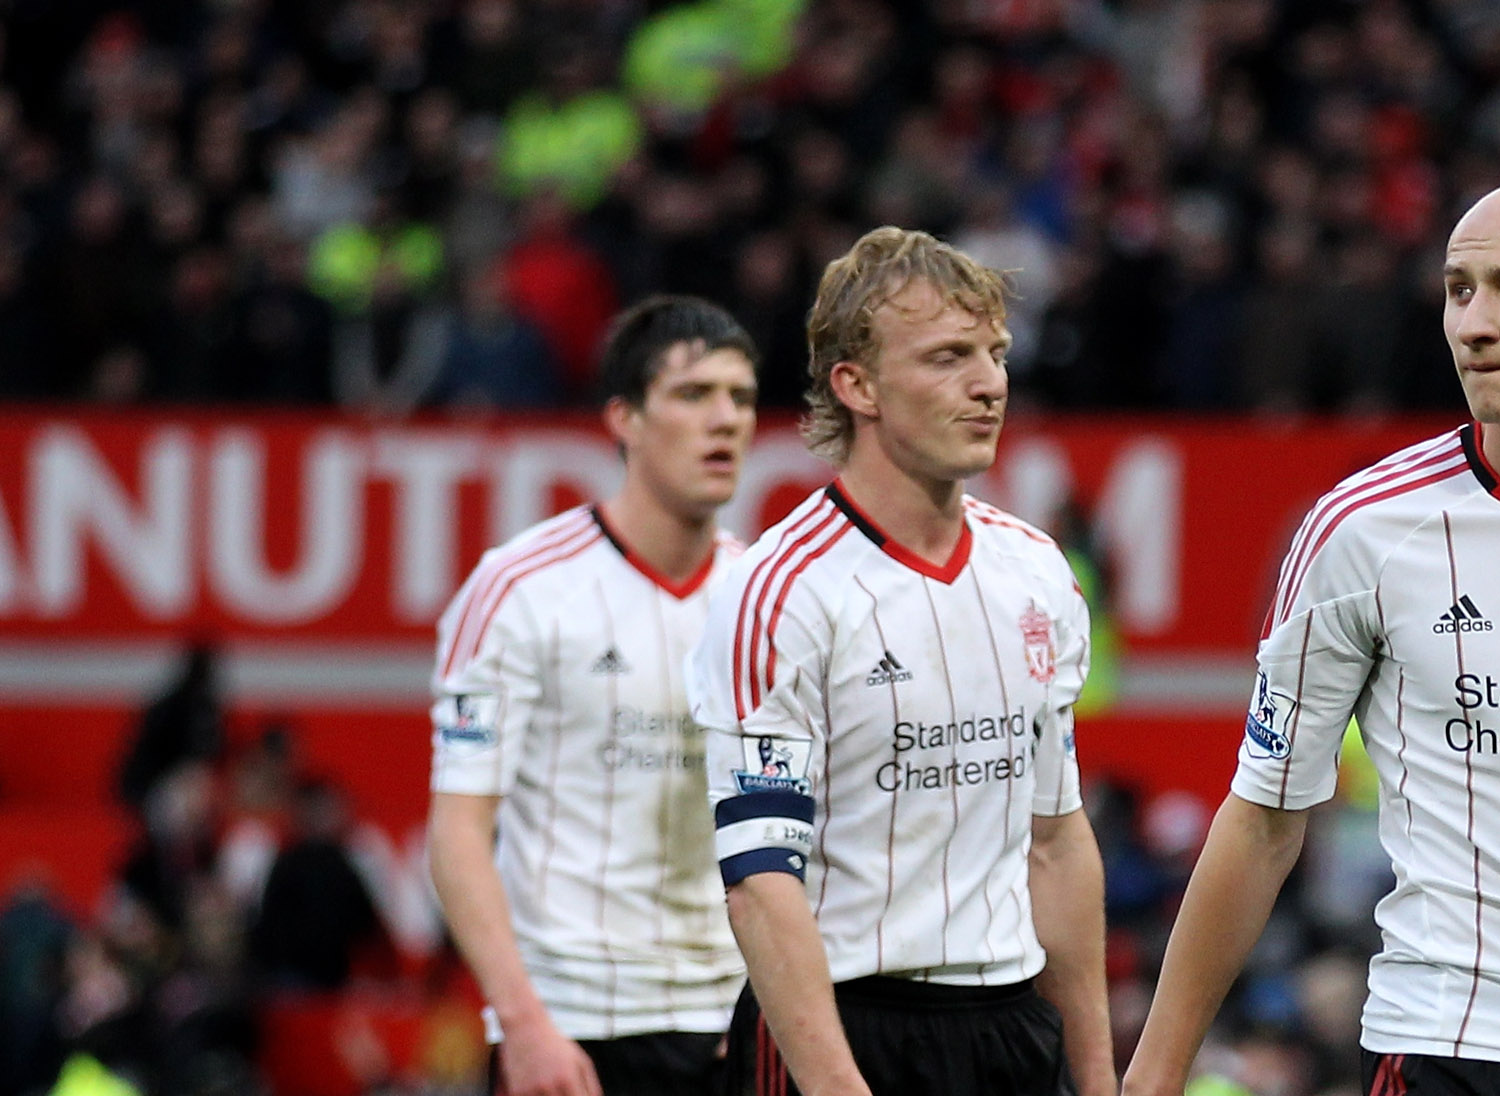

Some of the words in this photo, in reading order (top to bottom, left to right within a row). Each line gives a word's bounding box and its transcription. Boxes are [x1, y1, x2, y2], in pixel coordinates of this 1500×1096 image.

[1432, 617, 1494, 634] adidas
[866, 669, 913, 687] adidas
[892, 705, 1025, 752] Standard
[876, 745, 1026, 793] Chartered
